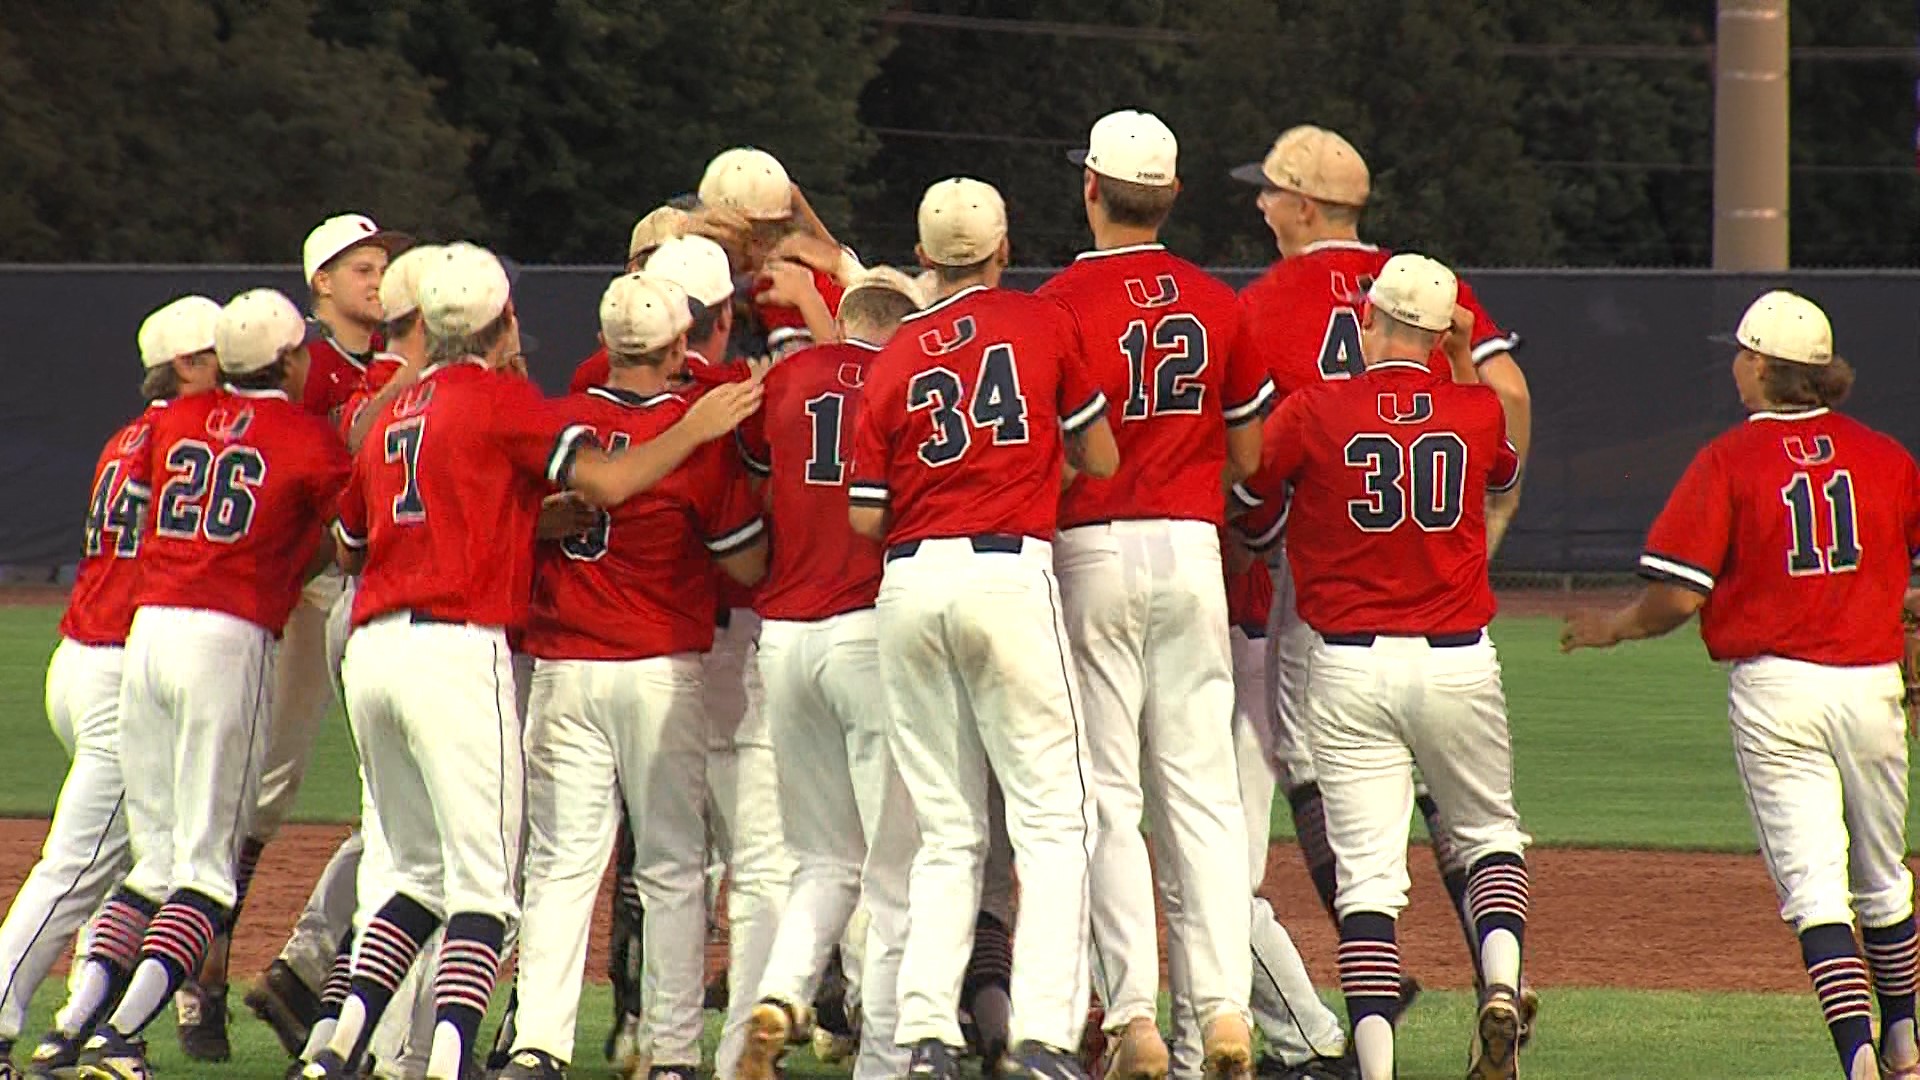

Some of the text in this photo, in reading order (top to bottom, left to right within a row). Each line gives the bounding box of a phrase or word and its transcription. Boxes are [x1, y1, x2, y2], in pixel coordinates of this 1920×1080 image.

[919, 316, 976, 356] U
[1124, 275, 1180, 308] U
[1118, 313, 1207, 423] 12
[1317, 306, 1368, 380] 4
[804, 391, 856, 486] 1
[906, 343, 1029, 468] 34
[1378, 393, 1432, 424] U
[1783, 435, 1835, 466] U
[84, 459, 146, 558] 44
[156, 438, 266, 543] 26
[384, 416, 426, 523] 7
[1344, 432, 1467, 532] 30
[1781, 469, 1862, 577] 11
